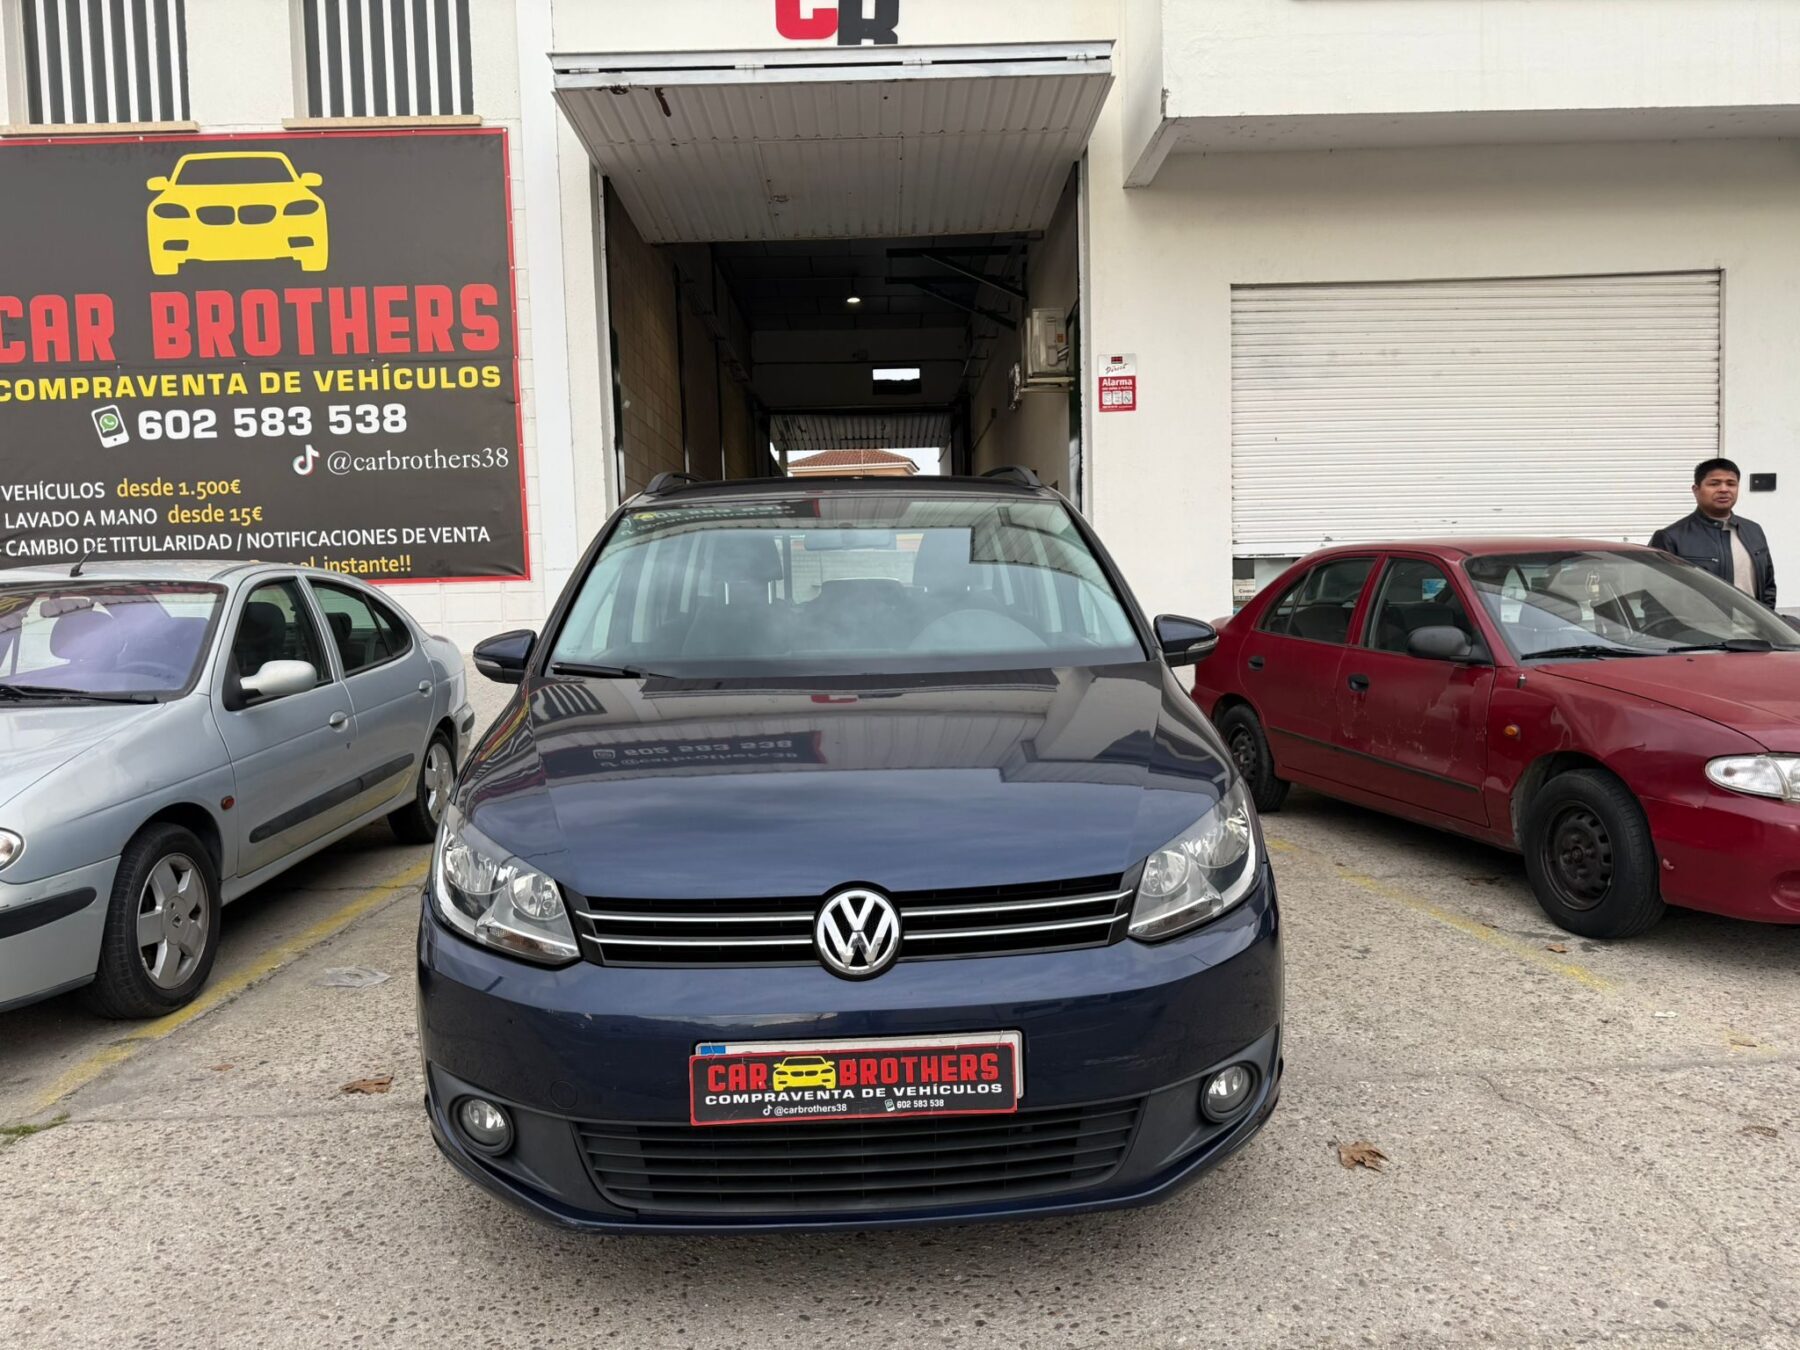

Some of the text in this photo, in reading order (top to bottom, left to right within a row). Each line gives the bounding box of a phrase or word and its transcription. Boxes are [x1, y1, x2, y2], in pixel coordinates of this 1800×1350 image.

[0, 283, 500, 364] CAR BROTHERS
[0, 363, 501, 401] COMPRAVENTA DE VEHÍCULOS
[1102, 378, 1133, 387] Alarma
[137, 403, 407, 440] 602 583 538
[327, 447, 509, 475] @carbrothers38
[0, 477, 242, 501] VEHÍCULOS desde 1.500€
[5, 503, 263, 529] LAVADO A MANO desde 15€
[5, 537, 79, 557] CAMBIO
[83, 537, 108, 554] DE
[109, 533, 233, 553] TITULARIDAD
[247, 528, 398, 549] NOTIFICACIONES
[402, 528, 427, 544] DE
[428, 526, 491, 543] VENTA
[324, 555, 411, 575] instante!!
[708, 1053, 999, 1092] CAR BROTHERS
[705, 1083, 1003, 1105] COMPRAVENTA DE VEHÍCULOS
[896, 1099, 945, 1109] 602 583 538
[774, 1103, 847, 1116] @carbrothers38
